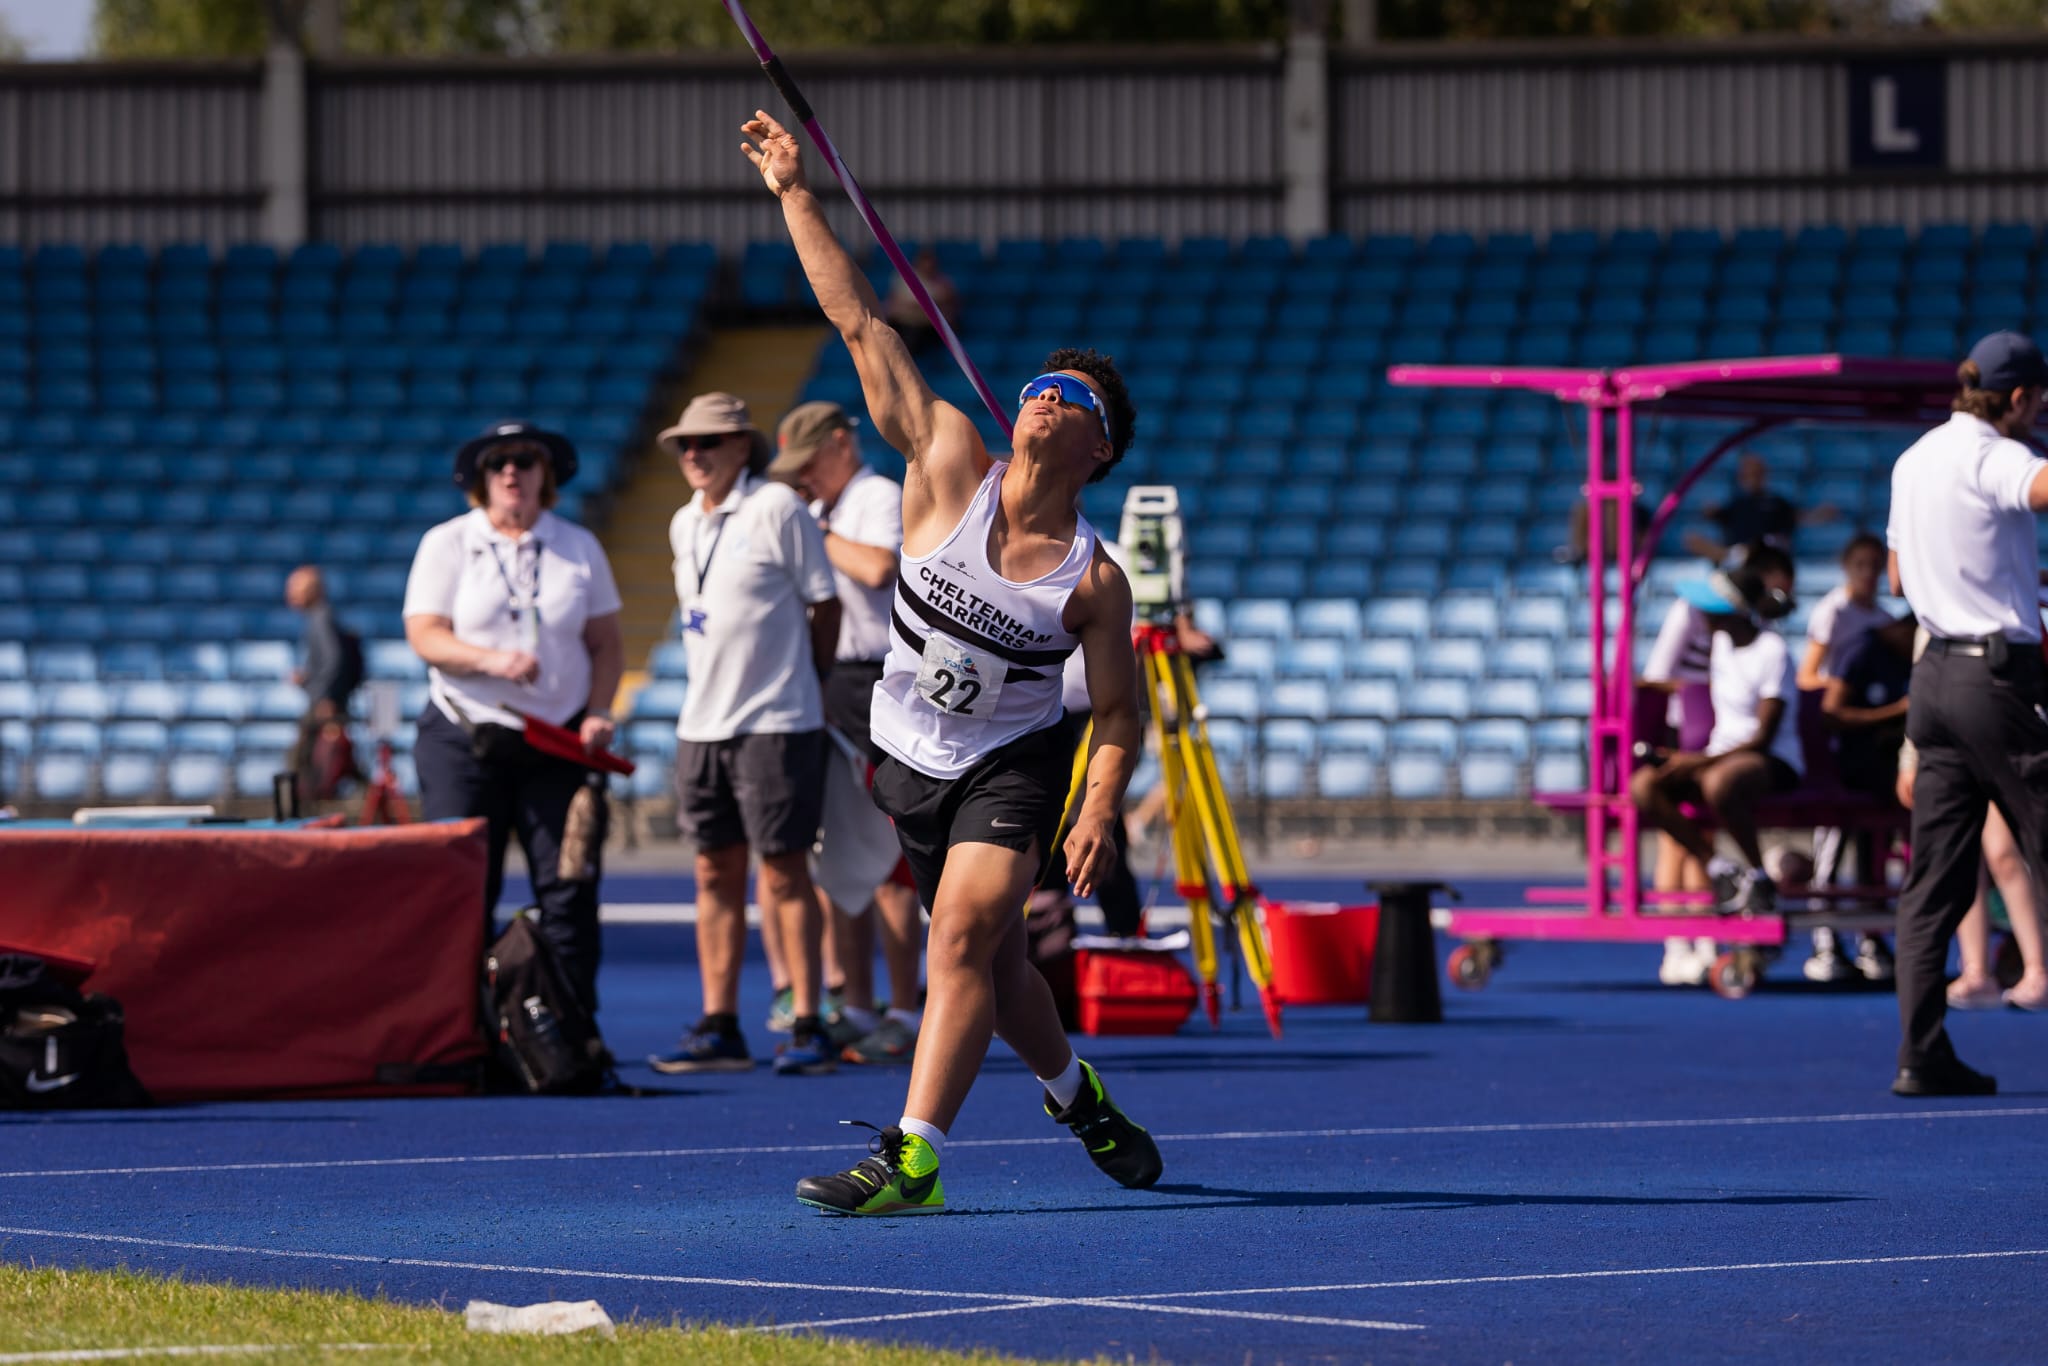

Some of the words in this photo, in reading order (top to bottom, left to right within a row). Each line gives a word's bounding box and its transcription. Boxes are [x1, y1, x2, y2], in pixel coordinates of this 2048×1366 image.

[1870, 75, 1920, 150] L
[920, 567, 1053, 643] CHELTENHAM
[927, 590, 1027, 649] HARRIERS
[929, 669, 981, 714] 22
